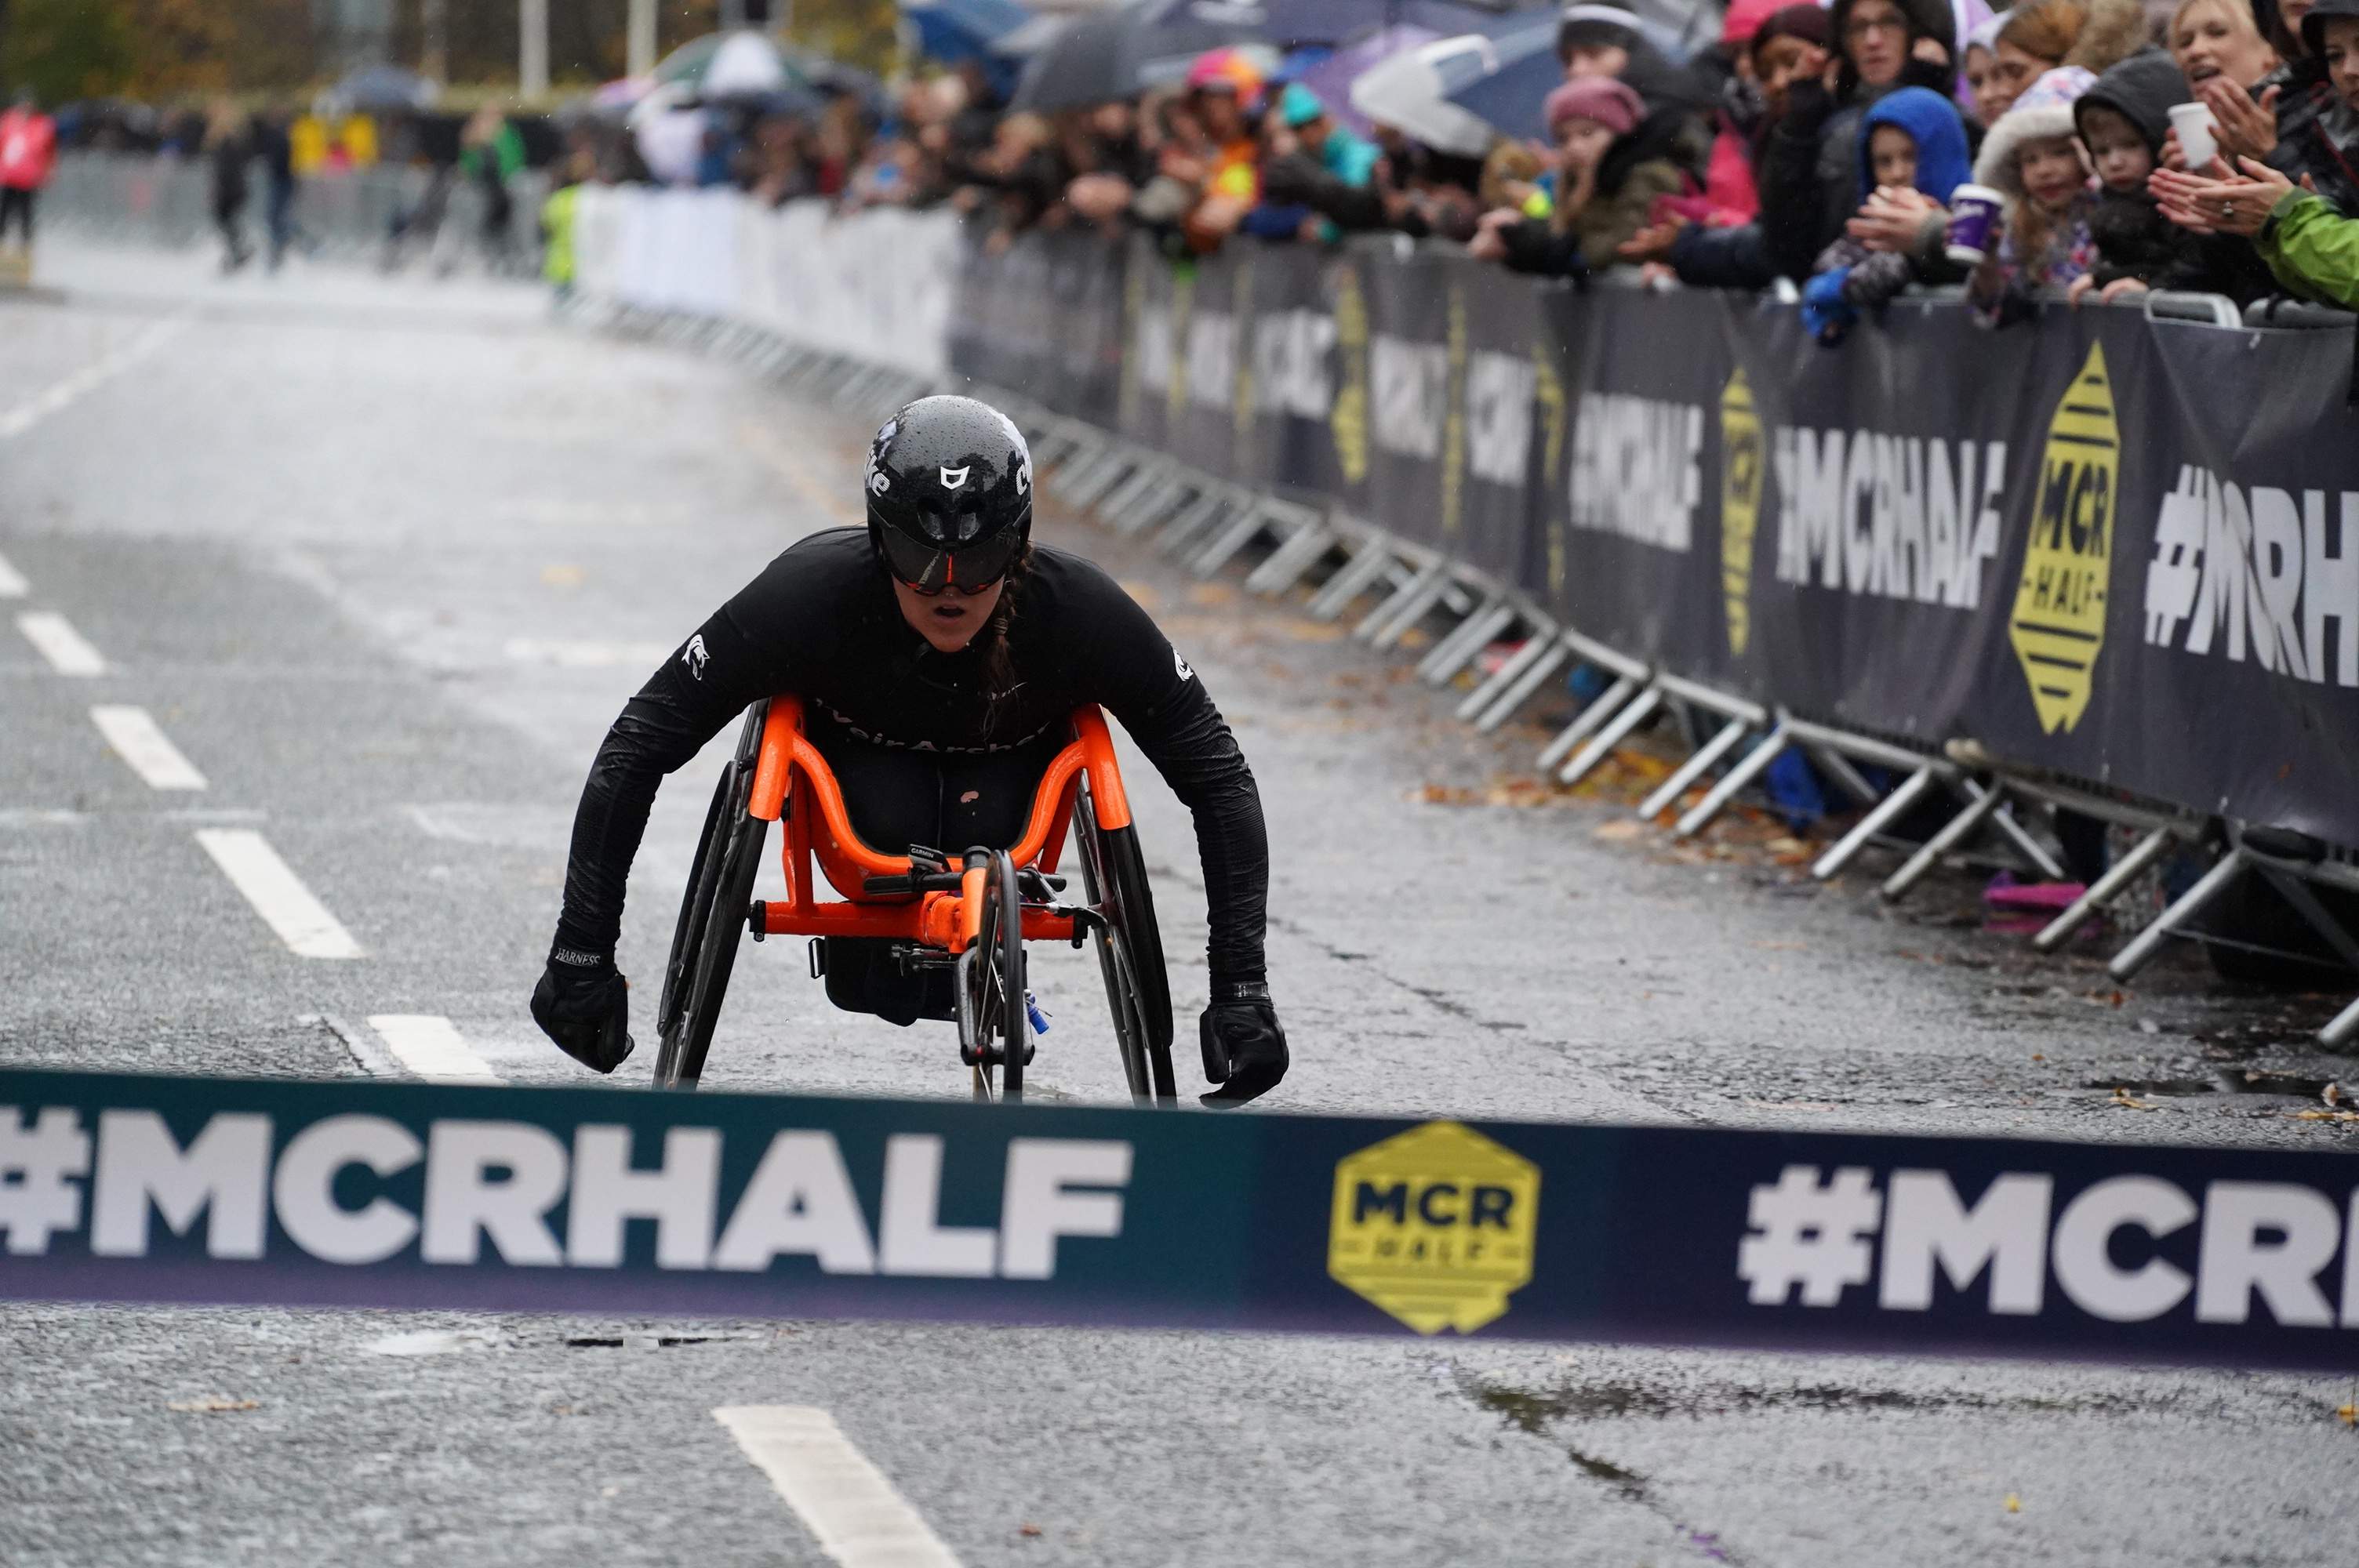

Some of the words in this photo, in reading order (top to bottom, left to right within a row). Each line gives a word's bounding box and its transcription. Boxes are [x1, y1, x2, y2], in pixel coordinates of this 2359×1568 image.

[2037, 458, 2109, 558] MCR
[2033, 565, 2095, 616] HALF
[911, 848, 934, 858] GARMIN
[554, 947, 601, 966] HARNESS
[0, 1105, 1134, 1281] #MCRHALF
[1354, 1181, 1514, 1229] MCR
[1736, 1164, 2359, 1330] #MCR
